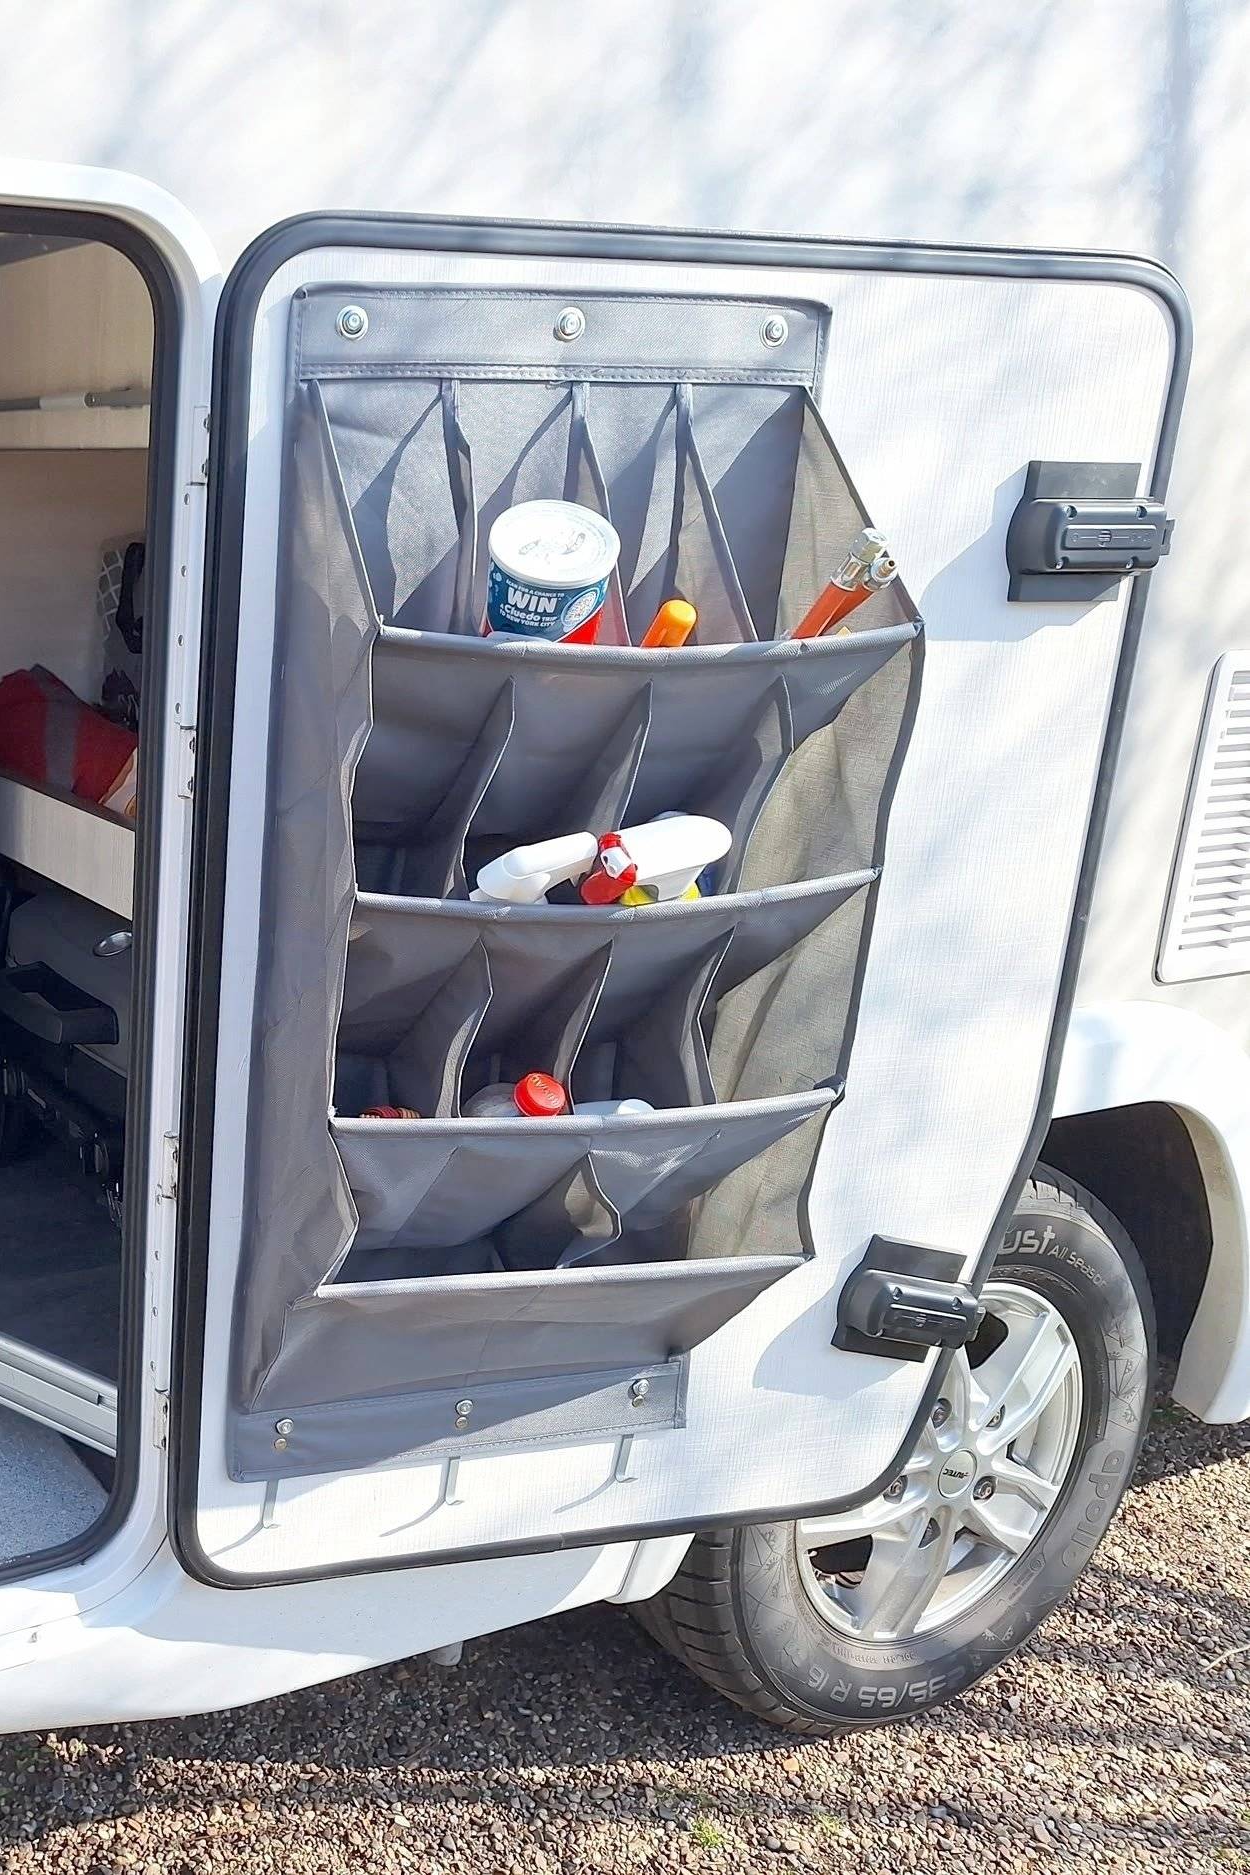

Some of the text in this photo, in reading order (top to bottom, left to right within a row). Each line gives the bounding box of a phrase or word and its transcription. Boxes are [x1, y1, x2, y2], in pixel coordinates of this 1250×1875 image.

[507, 586, 558, 613] WIN
[504, 604, 541, 621] Cluedo
[506, 613, 521, 623] NEW
[521, 619, 539, 627] YORK
[1047, 1244, 1068, 1259] All
[1061, 1451, 1126, 1567] apollo
